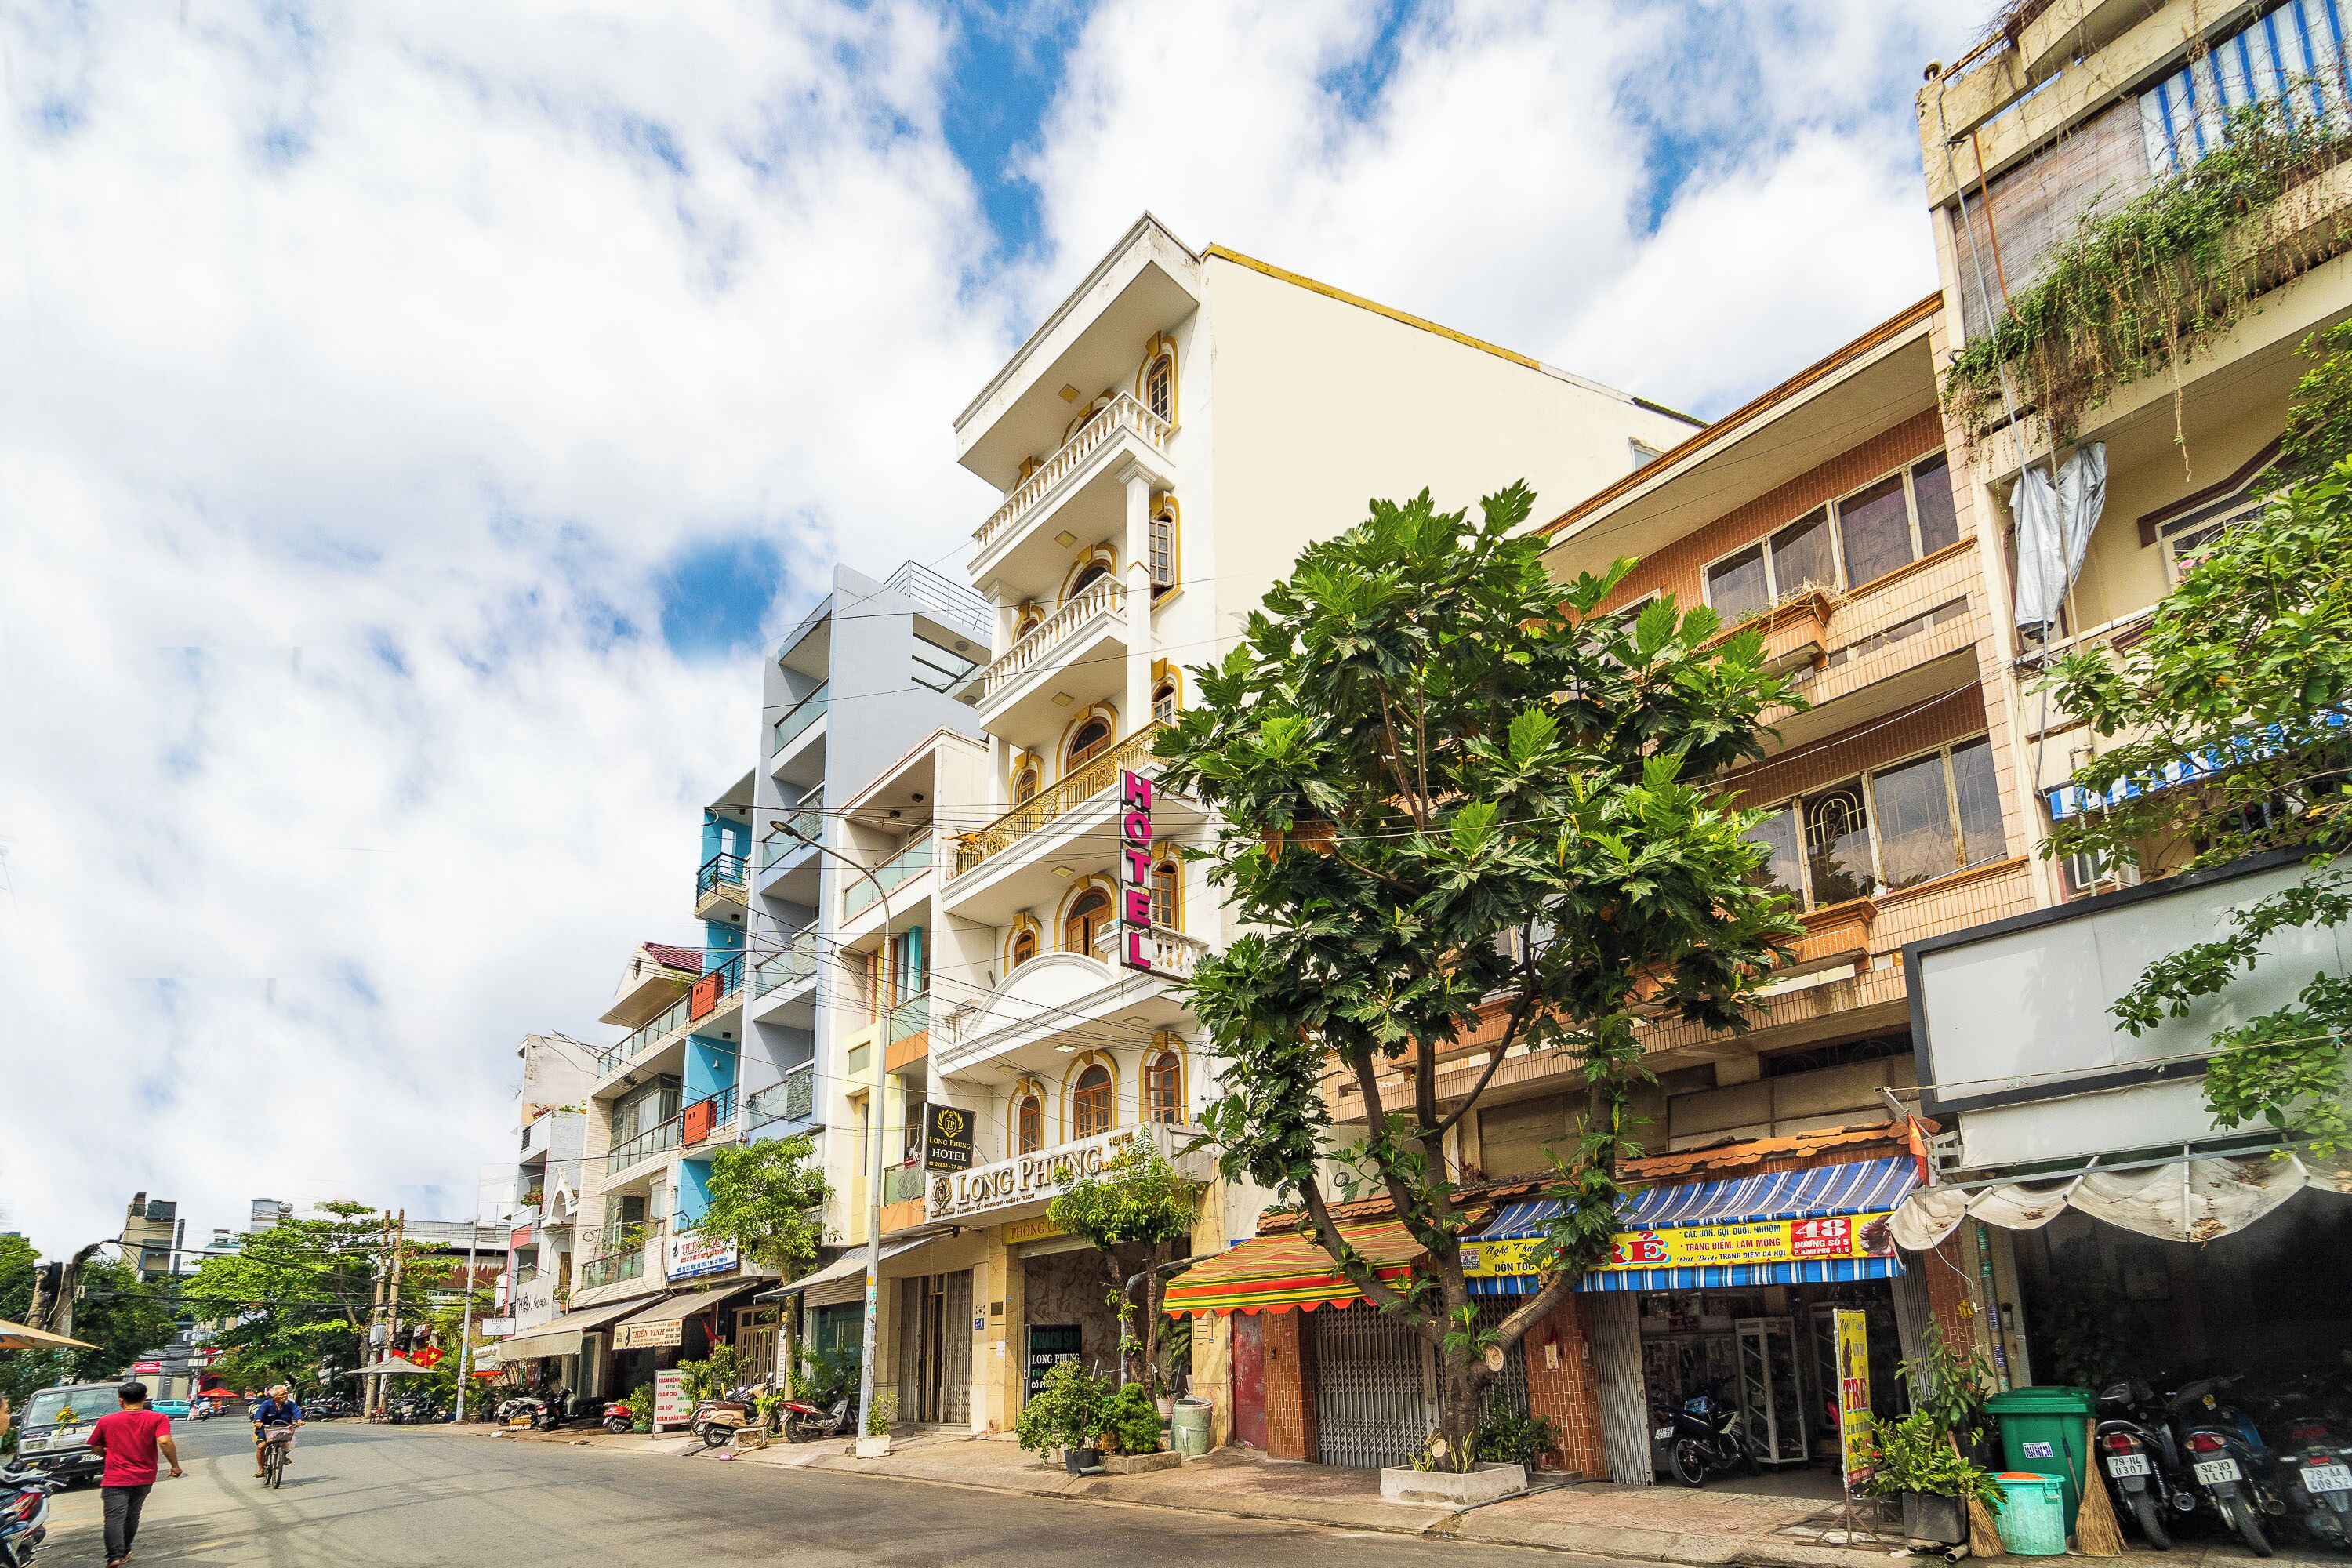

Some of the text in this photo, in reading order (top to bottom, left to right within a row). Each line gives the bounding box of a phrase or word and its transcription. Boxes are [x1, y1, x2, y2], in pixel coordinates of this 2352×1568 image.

[1124, 770, 1152, 968] HOTEL
[929, 1136, 971, 1149] LONG PHUNG
[1109, 1131, 1134, 1147] HOTEL
[931, 1148, 967, 1161] HOTEL
[956, 1168, 1014, 1205] LONG
[1011, 1221, 1044, 1239] PHÒNG
[1795, 1219, 1846, 1238] 48
[1686, 1243, 1710, 1251] TRANG
[1737, 1237, 1753, 1248] LÀM
[1794, 1239, 1825, 1248] ĐƯỜNG
[1828, 1236, 1841, 1246] SỐ
[1485, 1243, 1510, 1260] Nghệ
[1719, 1251, 1740, 1260] TRANG
[1494, 1260, 1514, 1272] UỐN
[650, 1328, 665, 1337] VINH
[1032, 1353, 1080, 1364] LONG PHUNG
[1032, 1380, 1039, 1388] CÓ
[1843, 1365, 1868, 1413] TRẺ
[2113, 1457, 2142, 1467] 79-H4
[2201, 1461, 2231, 1473] 92-H3
[2115, 1465, 2143, 1475] 0307
[2204, 1471, 2234, 1483] 1417
